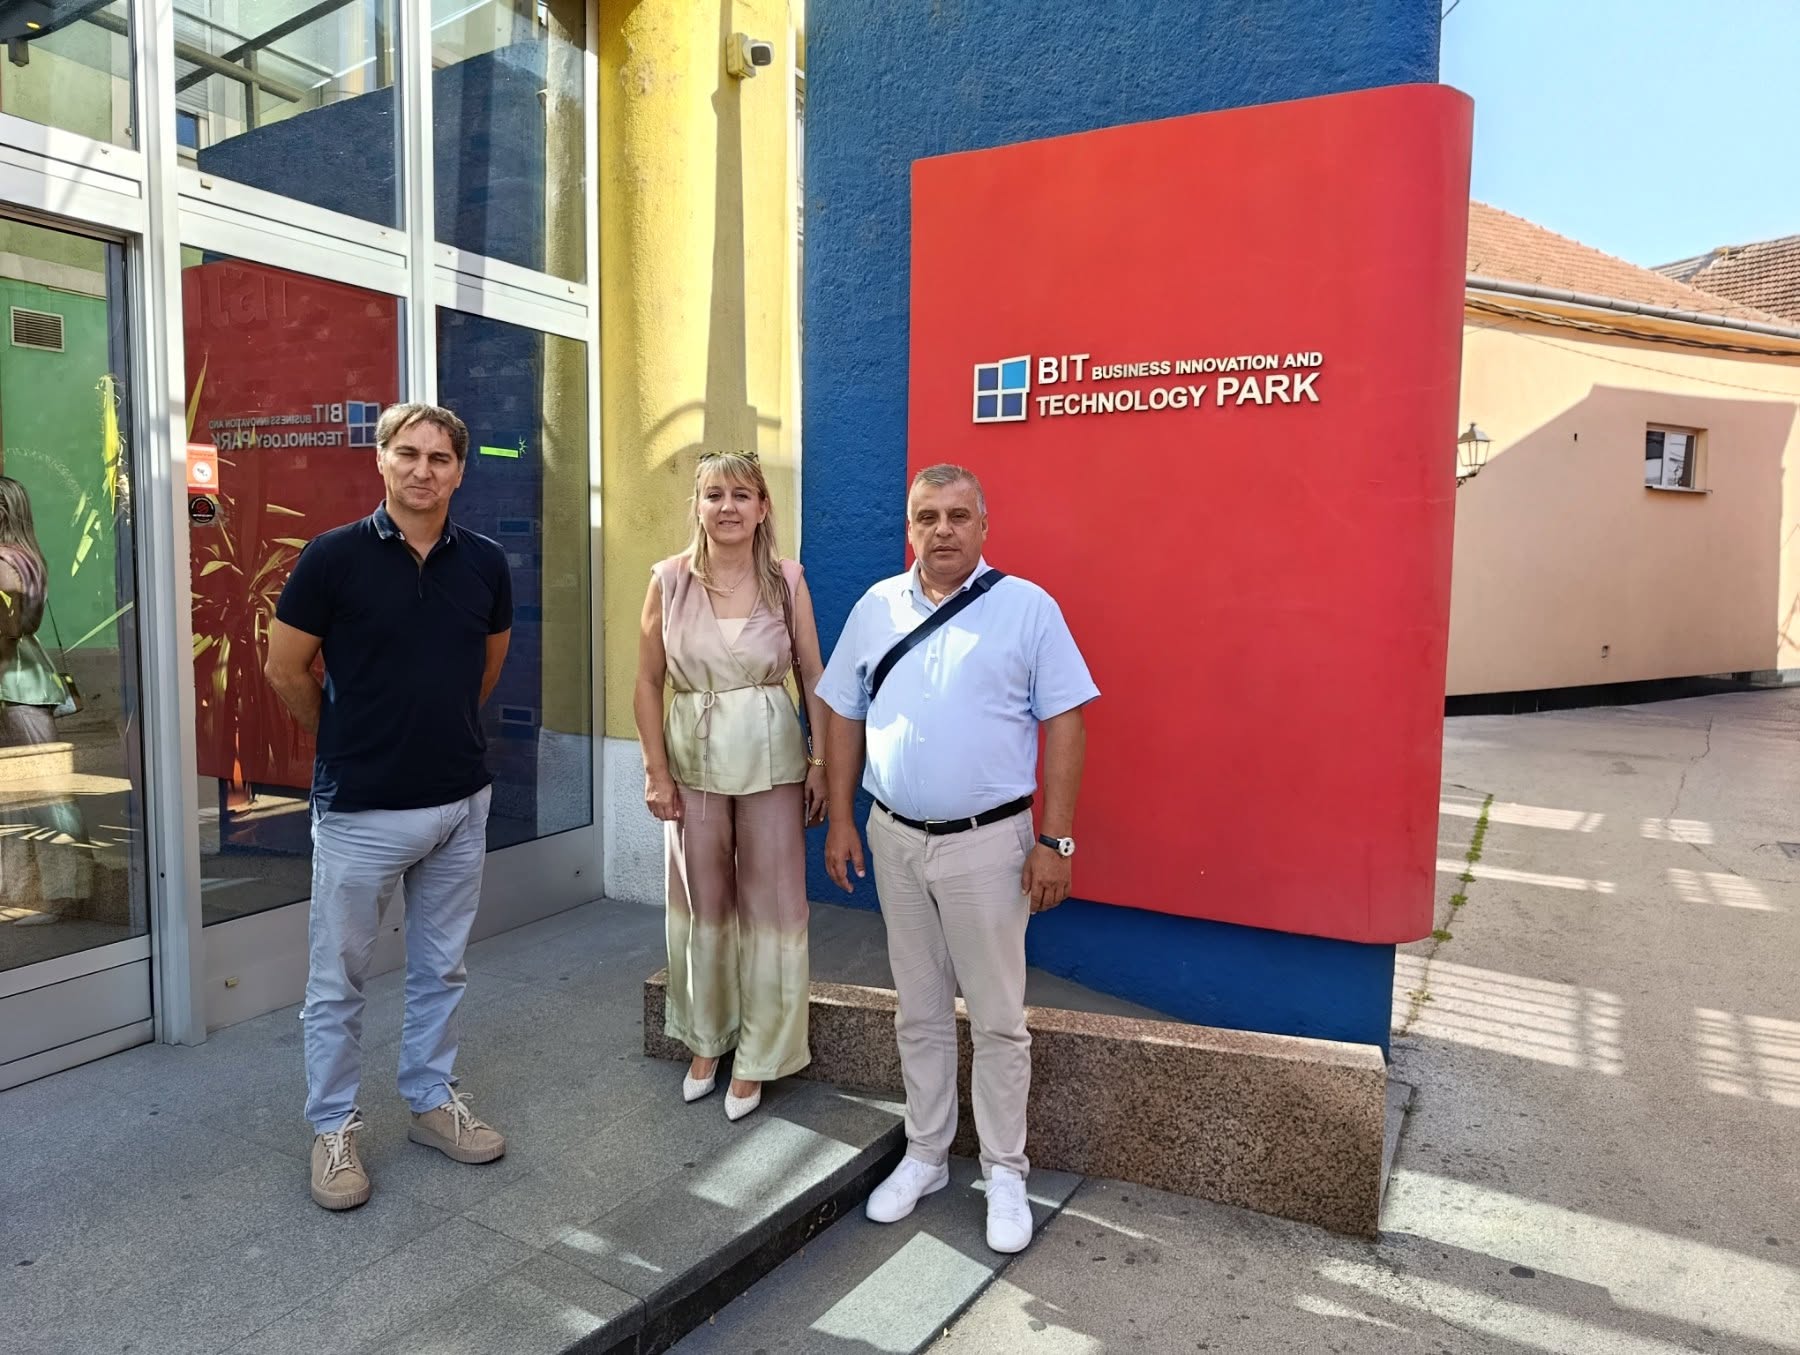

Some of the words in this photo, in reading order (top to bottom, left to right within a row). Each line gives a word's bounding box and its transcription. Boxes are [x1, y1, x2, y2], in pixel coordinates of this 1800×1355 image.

[1038, 353, 1090, 384] BIT
[1092, 360, 1171, 380] BUSINESS
[1175, 354, 1279, 375] INNOVATION
[1283, 351, 1323, 369] AND
[1035, 385, 1207, 417] TECHNOLOGY
[1216, 372, 1321, 406] PARK
